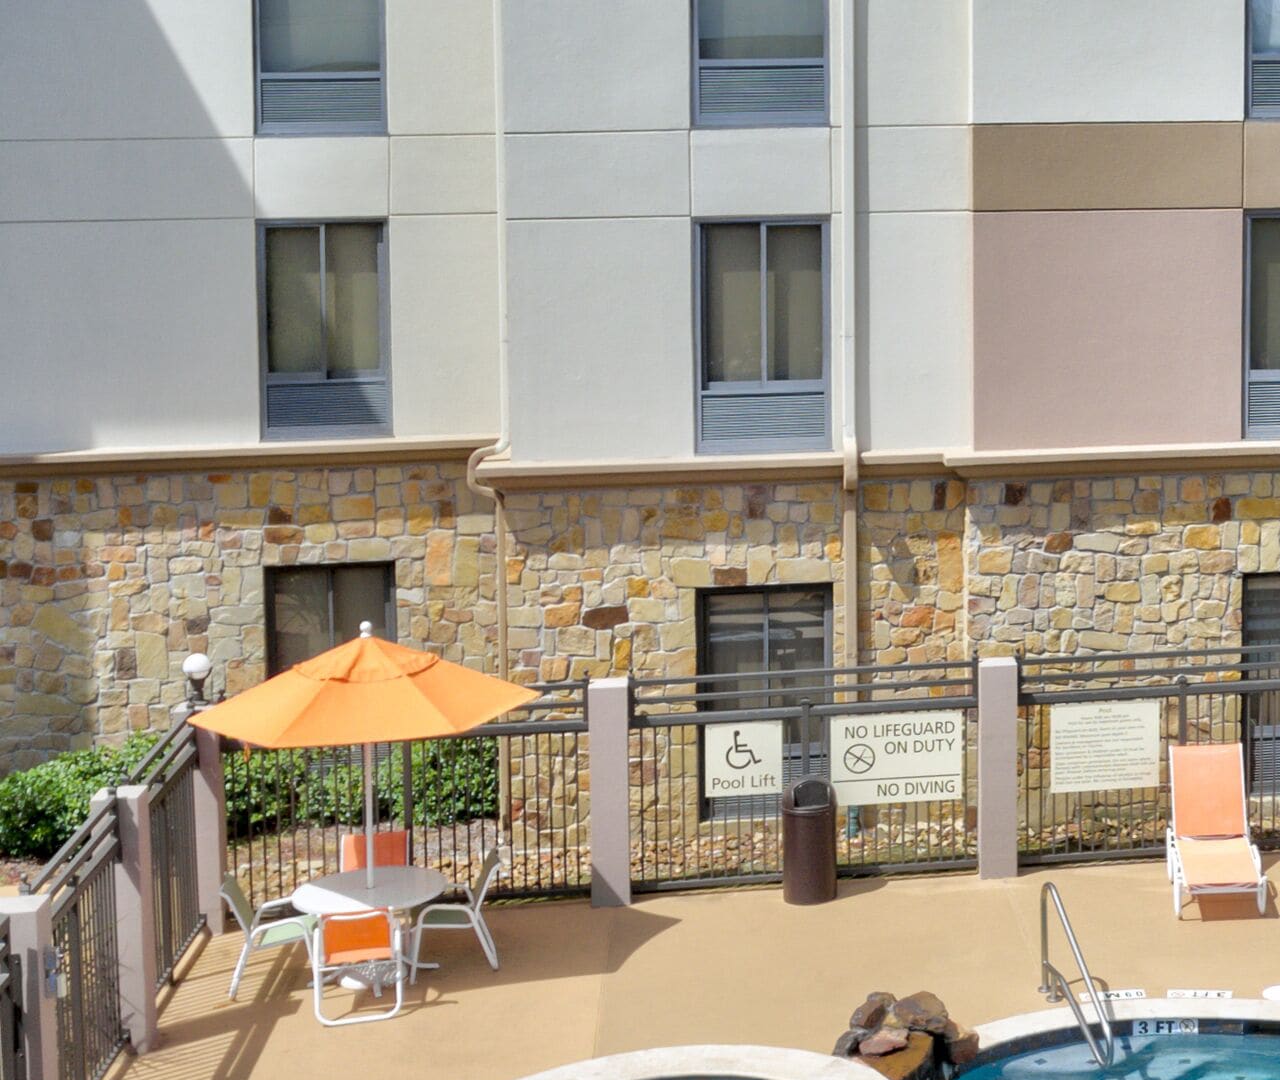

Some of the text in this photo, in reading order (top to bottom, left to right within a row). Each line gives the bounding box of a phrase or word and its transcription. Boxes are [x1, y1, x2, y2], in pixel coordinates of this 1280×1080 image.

[844, 721, 955, 739] NO LIFEGUARD
[884, 738, 955, 755] ON DUTY
[711, 773, 776, 790] Pool Lift
[876, 780, 956, 797] NO DIVING
[1138, 1021, 1175, 1034] 3 FT
